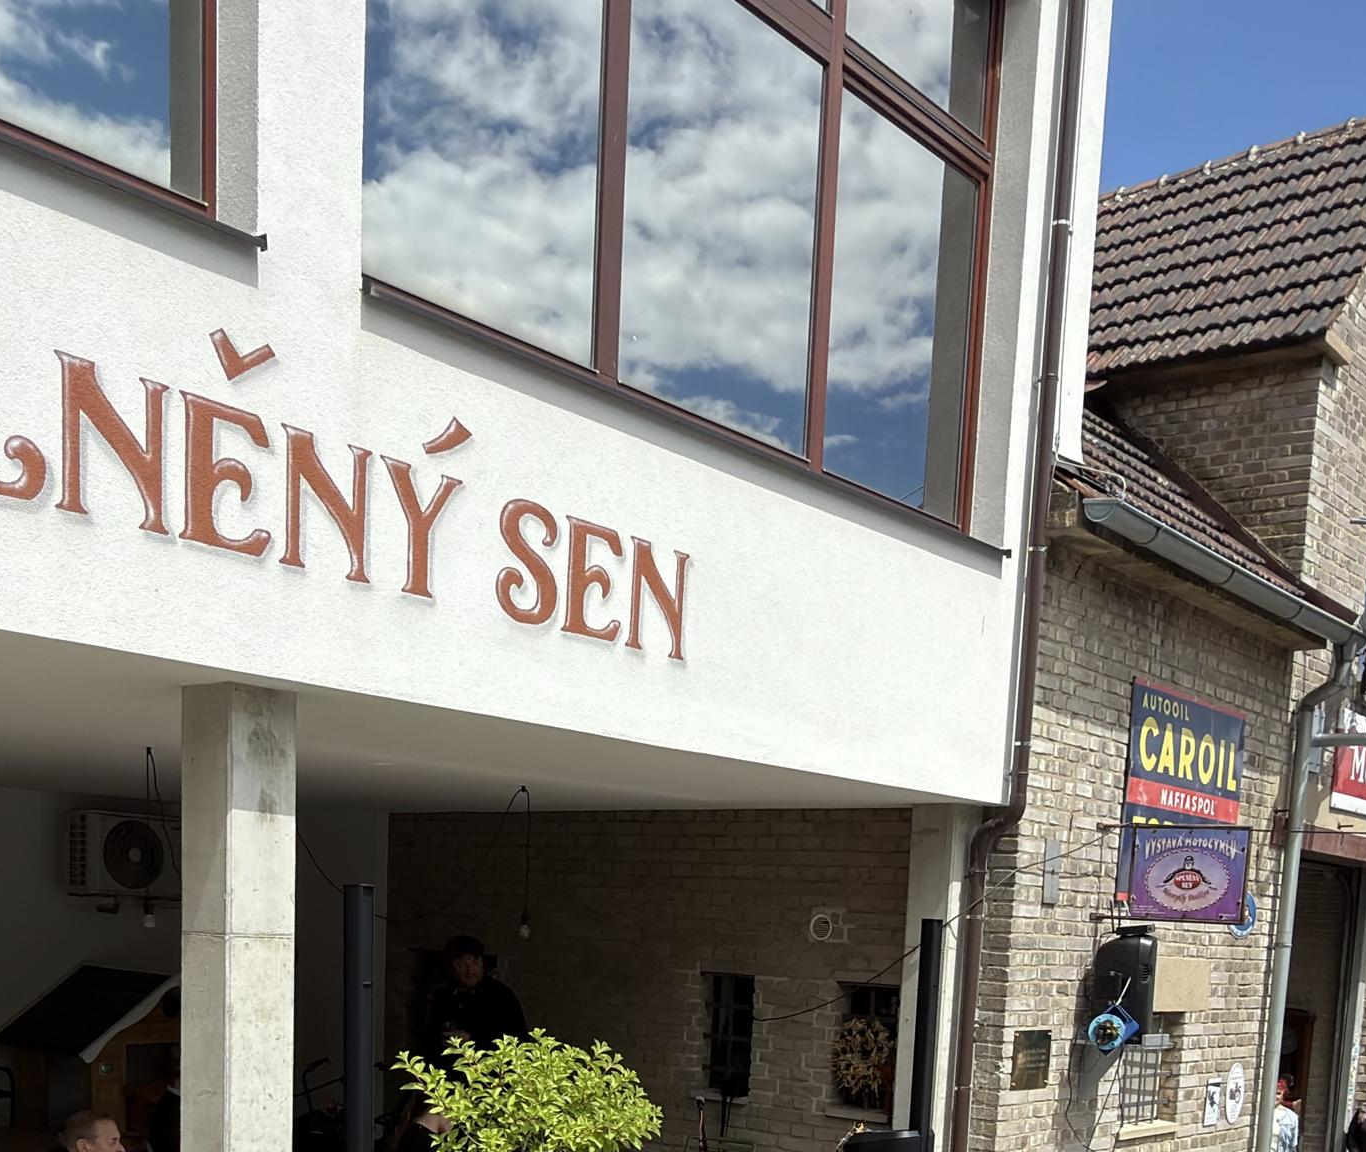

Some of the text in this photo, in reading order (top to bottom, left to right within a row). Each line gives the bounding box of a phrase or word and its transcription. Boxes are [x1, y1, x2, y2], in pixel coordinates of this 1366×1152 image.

[495, 497, 691, 661] SEN
[1142, 692, 1190, 721] AUTOOIL
[1139, 716, 1237, 792] CAROIL
[1160, 788, 1215, 816] NAFTASPOL
